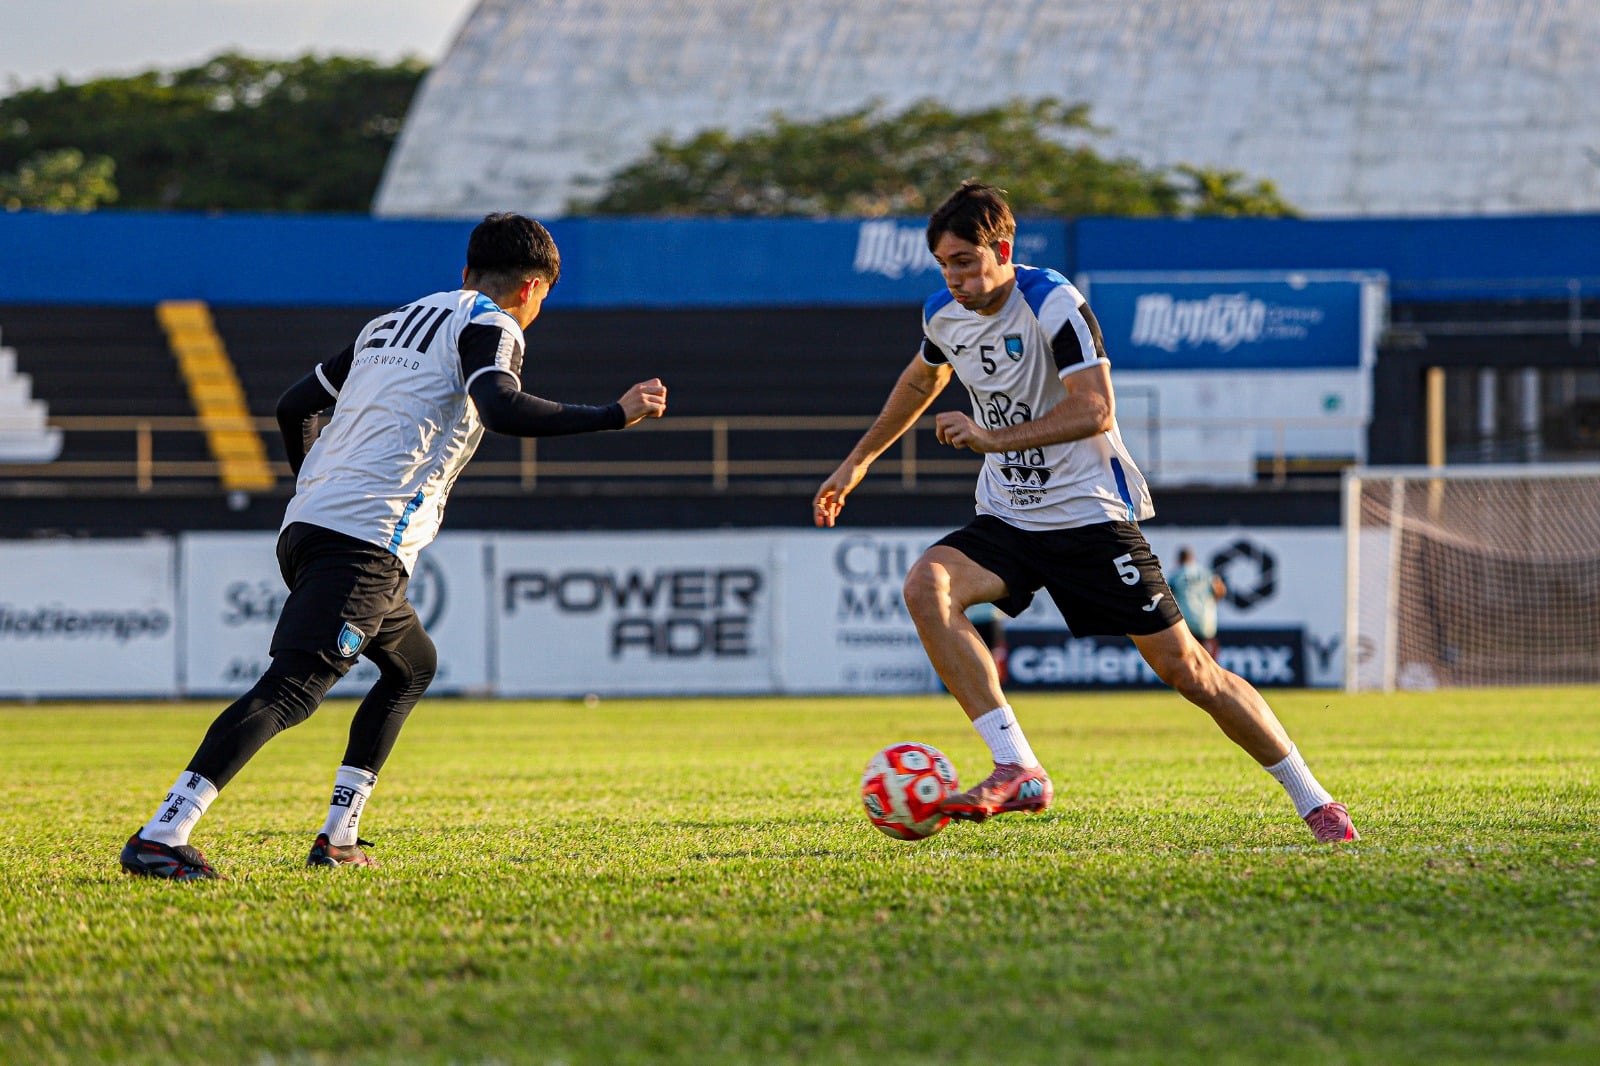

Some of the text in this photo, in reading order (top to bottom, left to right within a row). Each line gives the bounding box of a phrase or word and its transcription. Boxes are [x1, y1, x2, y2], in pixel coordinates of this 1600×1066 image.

[980, 345, 996, 375] 5
[1113, 554, 1141, 585] 5
[504, 567, 763, 615] POWER
[610, 616, 756, 660] ADE
